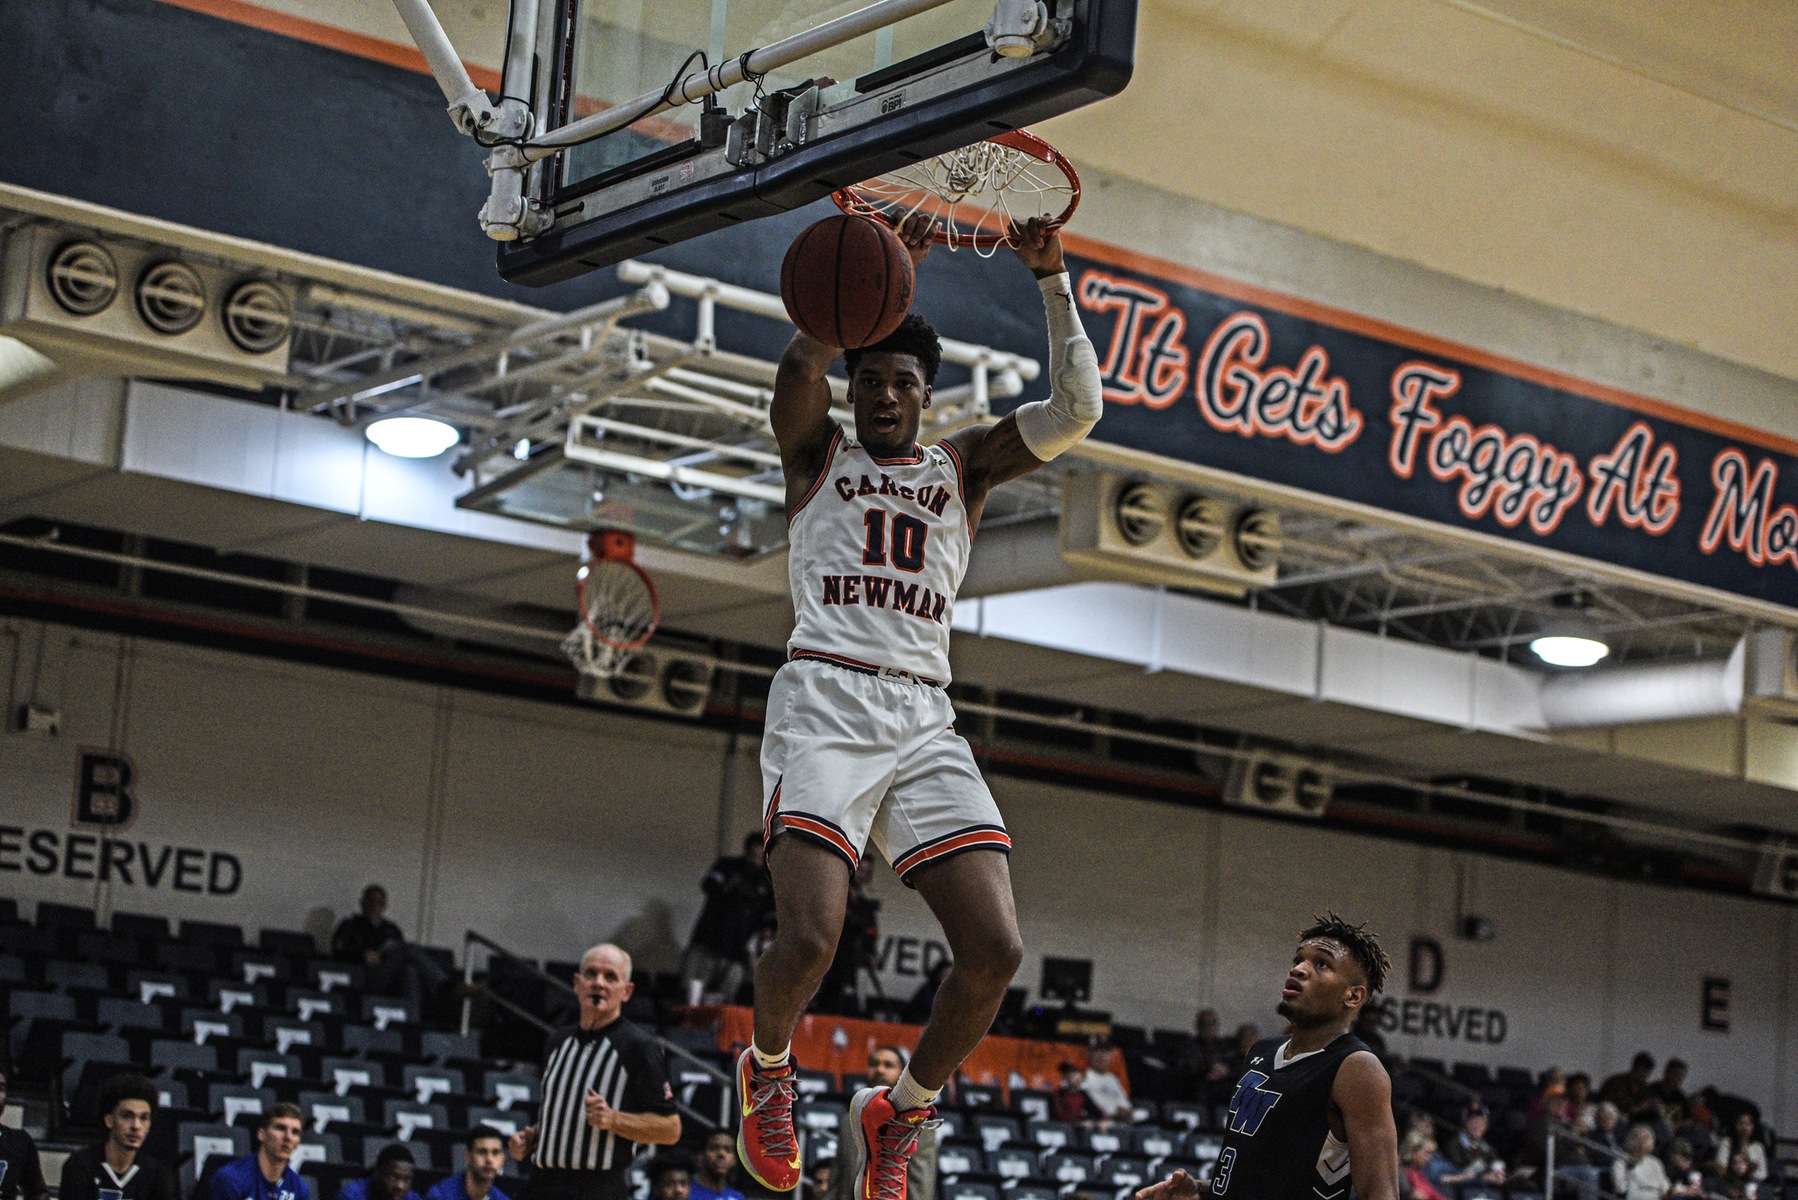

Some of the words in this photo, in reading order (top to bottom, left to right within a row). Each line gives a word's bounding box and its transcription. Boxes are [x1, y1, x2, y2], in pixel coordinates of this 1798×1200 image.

[1197, 312, 1363, 453] Gets
[1390, 362, 1583, 536] Foggy
[1588, 421, 1682, 535] At
[834, 473, 951, 517] CARSON
[862, 508, 928, 573] 10
[823, 575, 946, 624] NEWMAN
[72, 746, 140, 831] B
[1407, 933, 1446, 995] D
[1700, 974, 1731, 1033] E
[1212, 1146, 1237, 1196] 3
